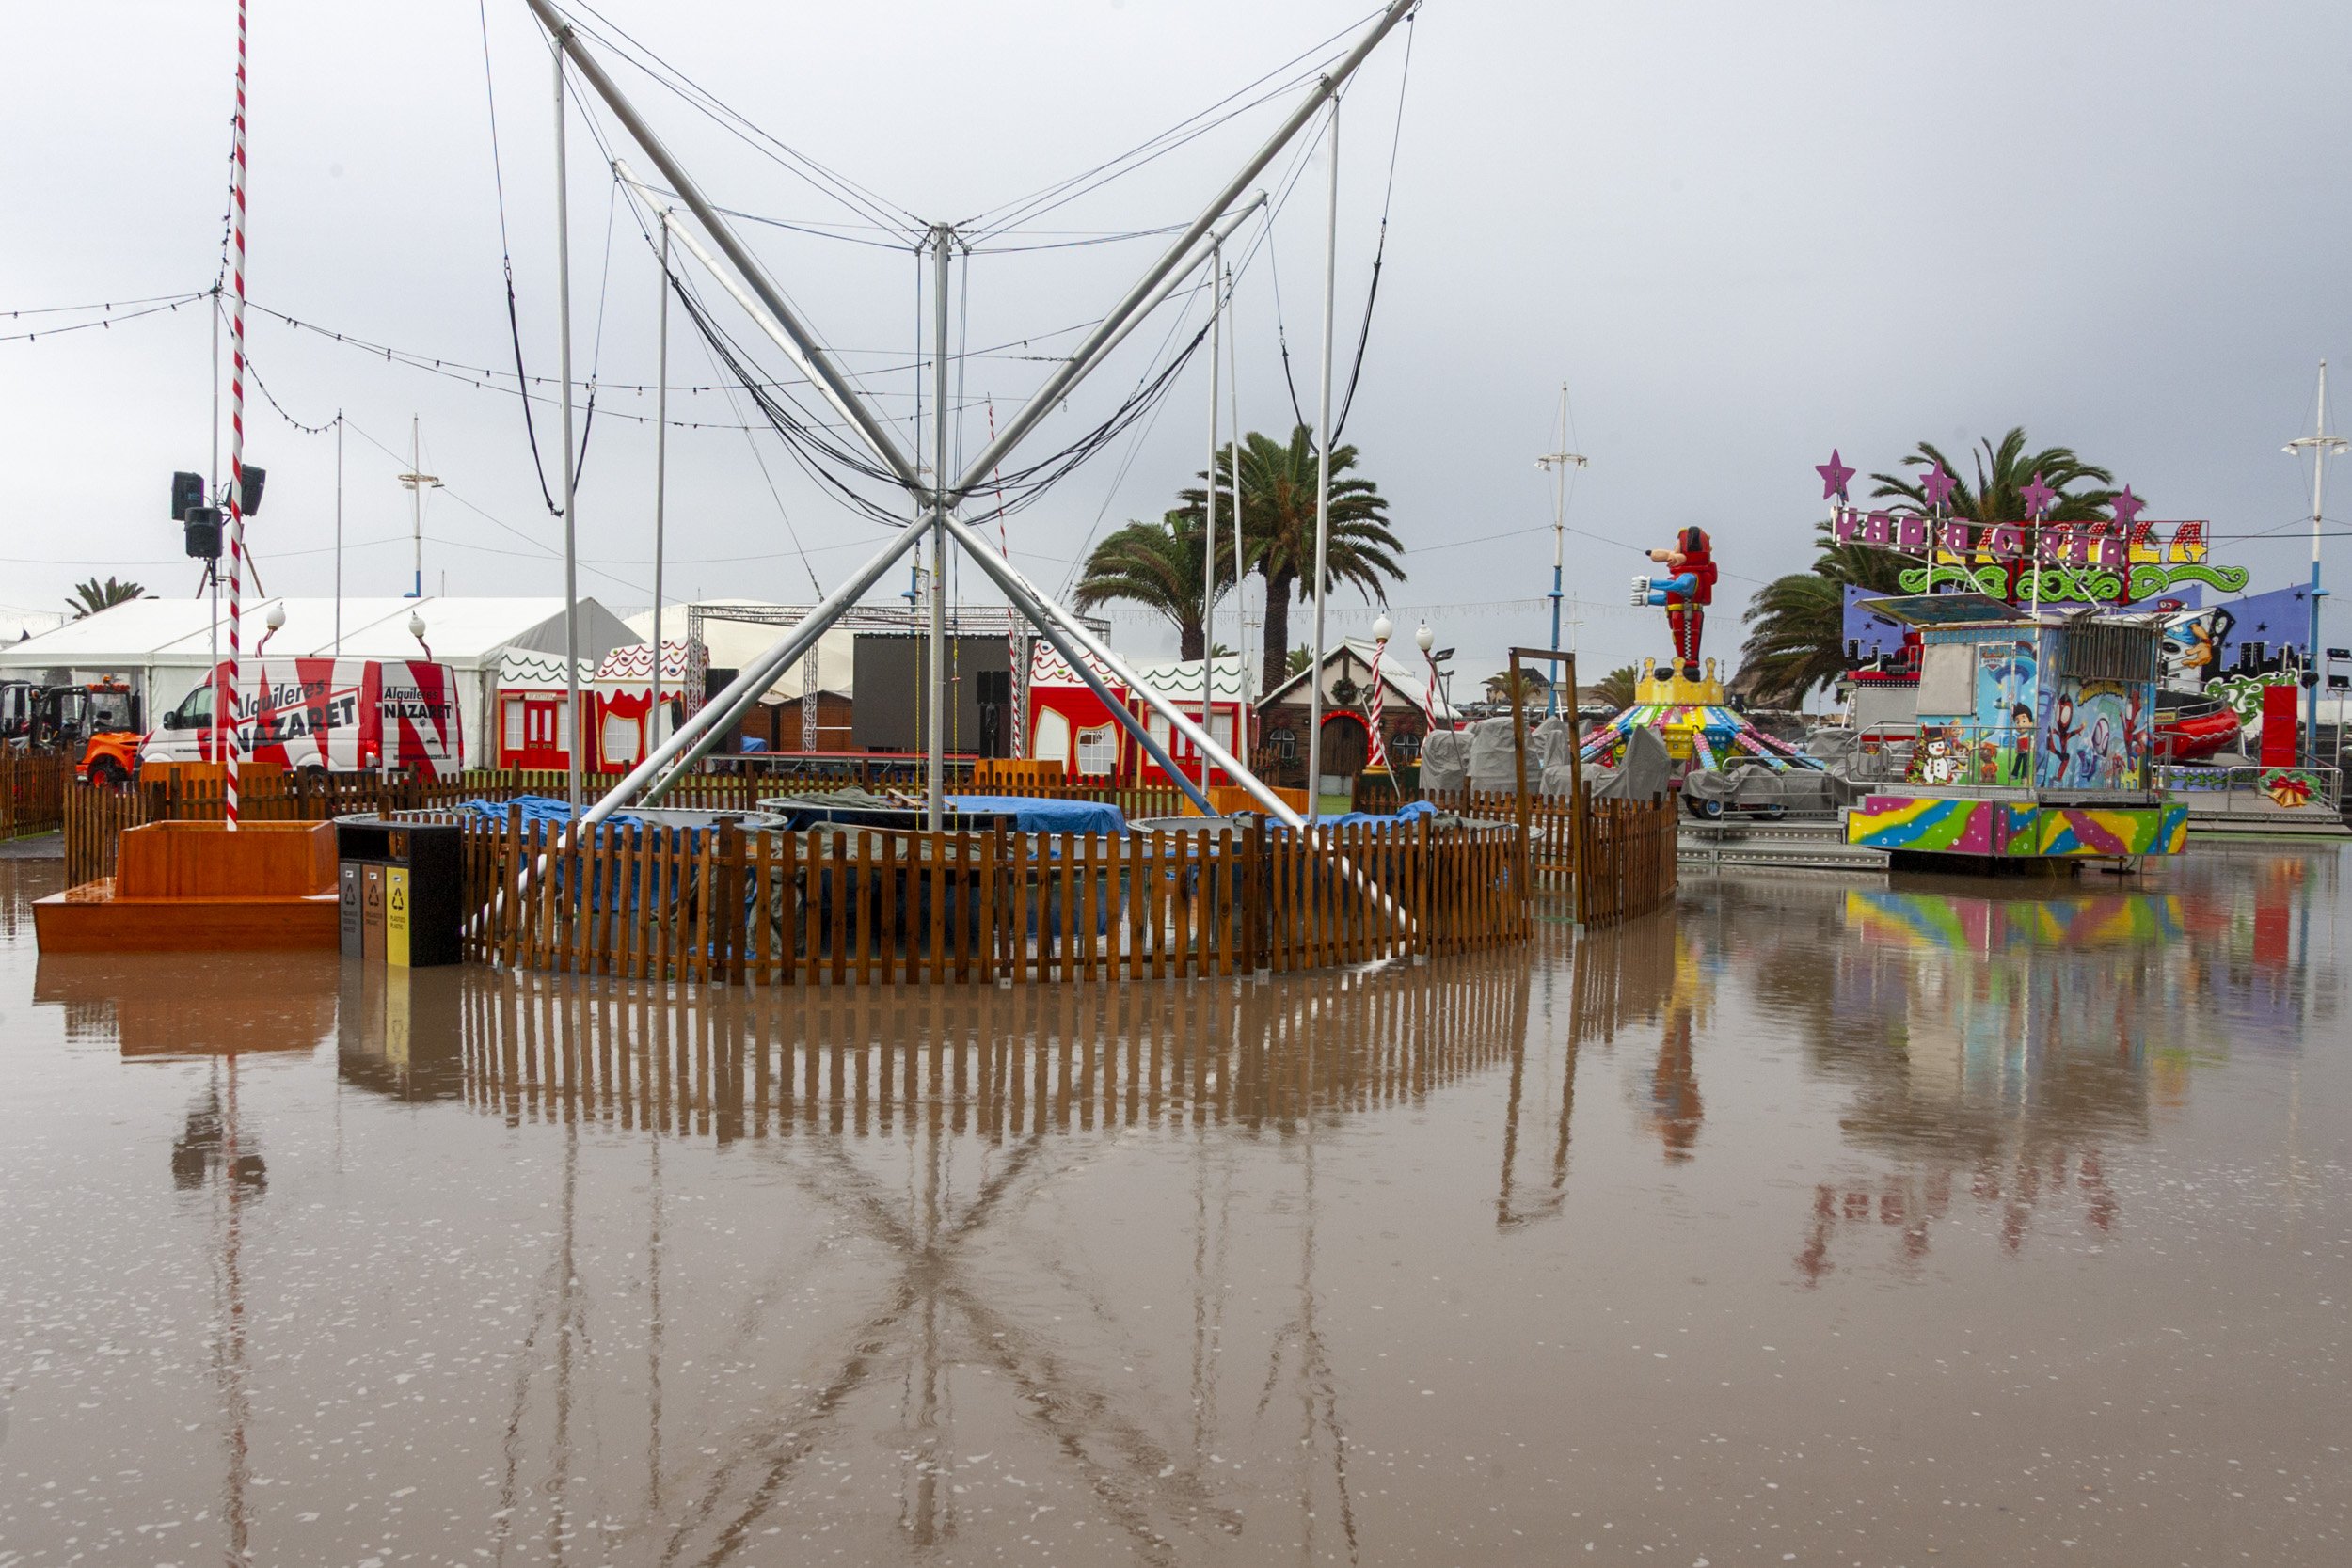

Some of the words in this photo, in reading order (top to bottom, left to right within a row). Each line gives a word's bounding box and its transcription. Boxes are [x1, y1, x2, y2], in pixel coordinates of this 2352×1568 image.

[384, 686, 437, 702] Alquileres
[384, 704, 452, 719] NAZARET
[237, 696, 356, 755] NAZARET
